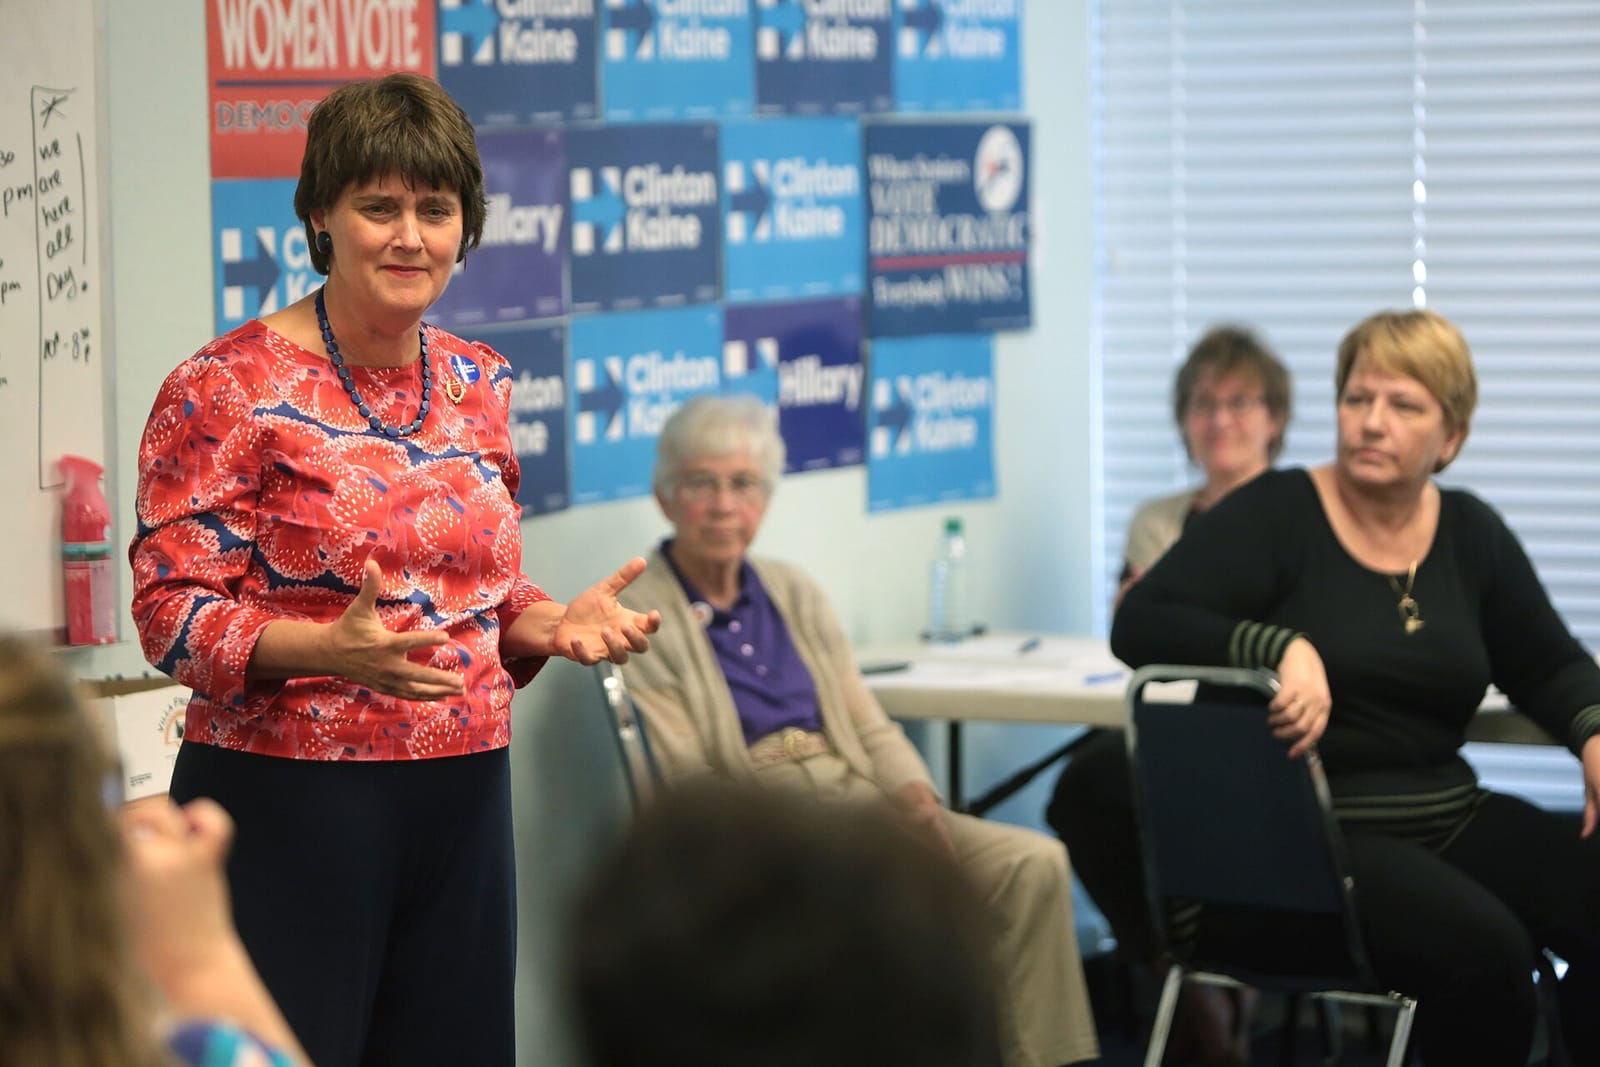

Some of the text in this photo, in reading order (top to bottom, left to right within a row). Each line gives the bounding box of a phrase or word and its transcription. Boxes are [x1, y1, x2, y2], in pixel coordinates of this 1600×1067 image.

[216, 0, 421, 70] WOMEN VOTE
[500, 17, 578, 64] Kaine
[658, 17, 732, 61] Kaine
[805, 18, 879, 61] Kaine
[943, 19, 1007, 59] Kaine
[215, 100, 315, 134] DEMOC
[39, 139, 60, 160] we
[39, 169, 61, 193] are
[624, 163, 717, 207] Clinton
[773, 156, 859, 196] Clinton
[3, 186, 33, 217] pm
[41, 195, 73, 227] here
[774, 197, 845, 239] Kaine
[869, 182, 938, 214] VOTE
[46, 224, 73, 258] all
[480, 193, 563, 253] illary
[626, 207, 701, 251] Kaine
[869, 212, 1029, 254] DEMOCRATIC
[627, 351, 718, 393] Clinton
[779, 355, 863, 411] Hillary
[914, 371, 988, 409] Clinton
[915, 409, 977, 450] Kaine
